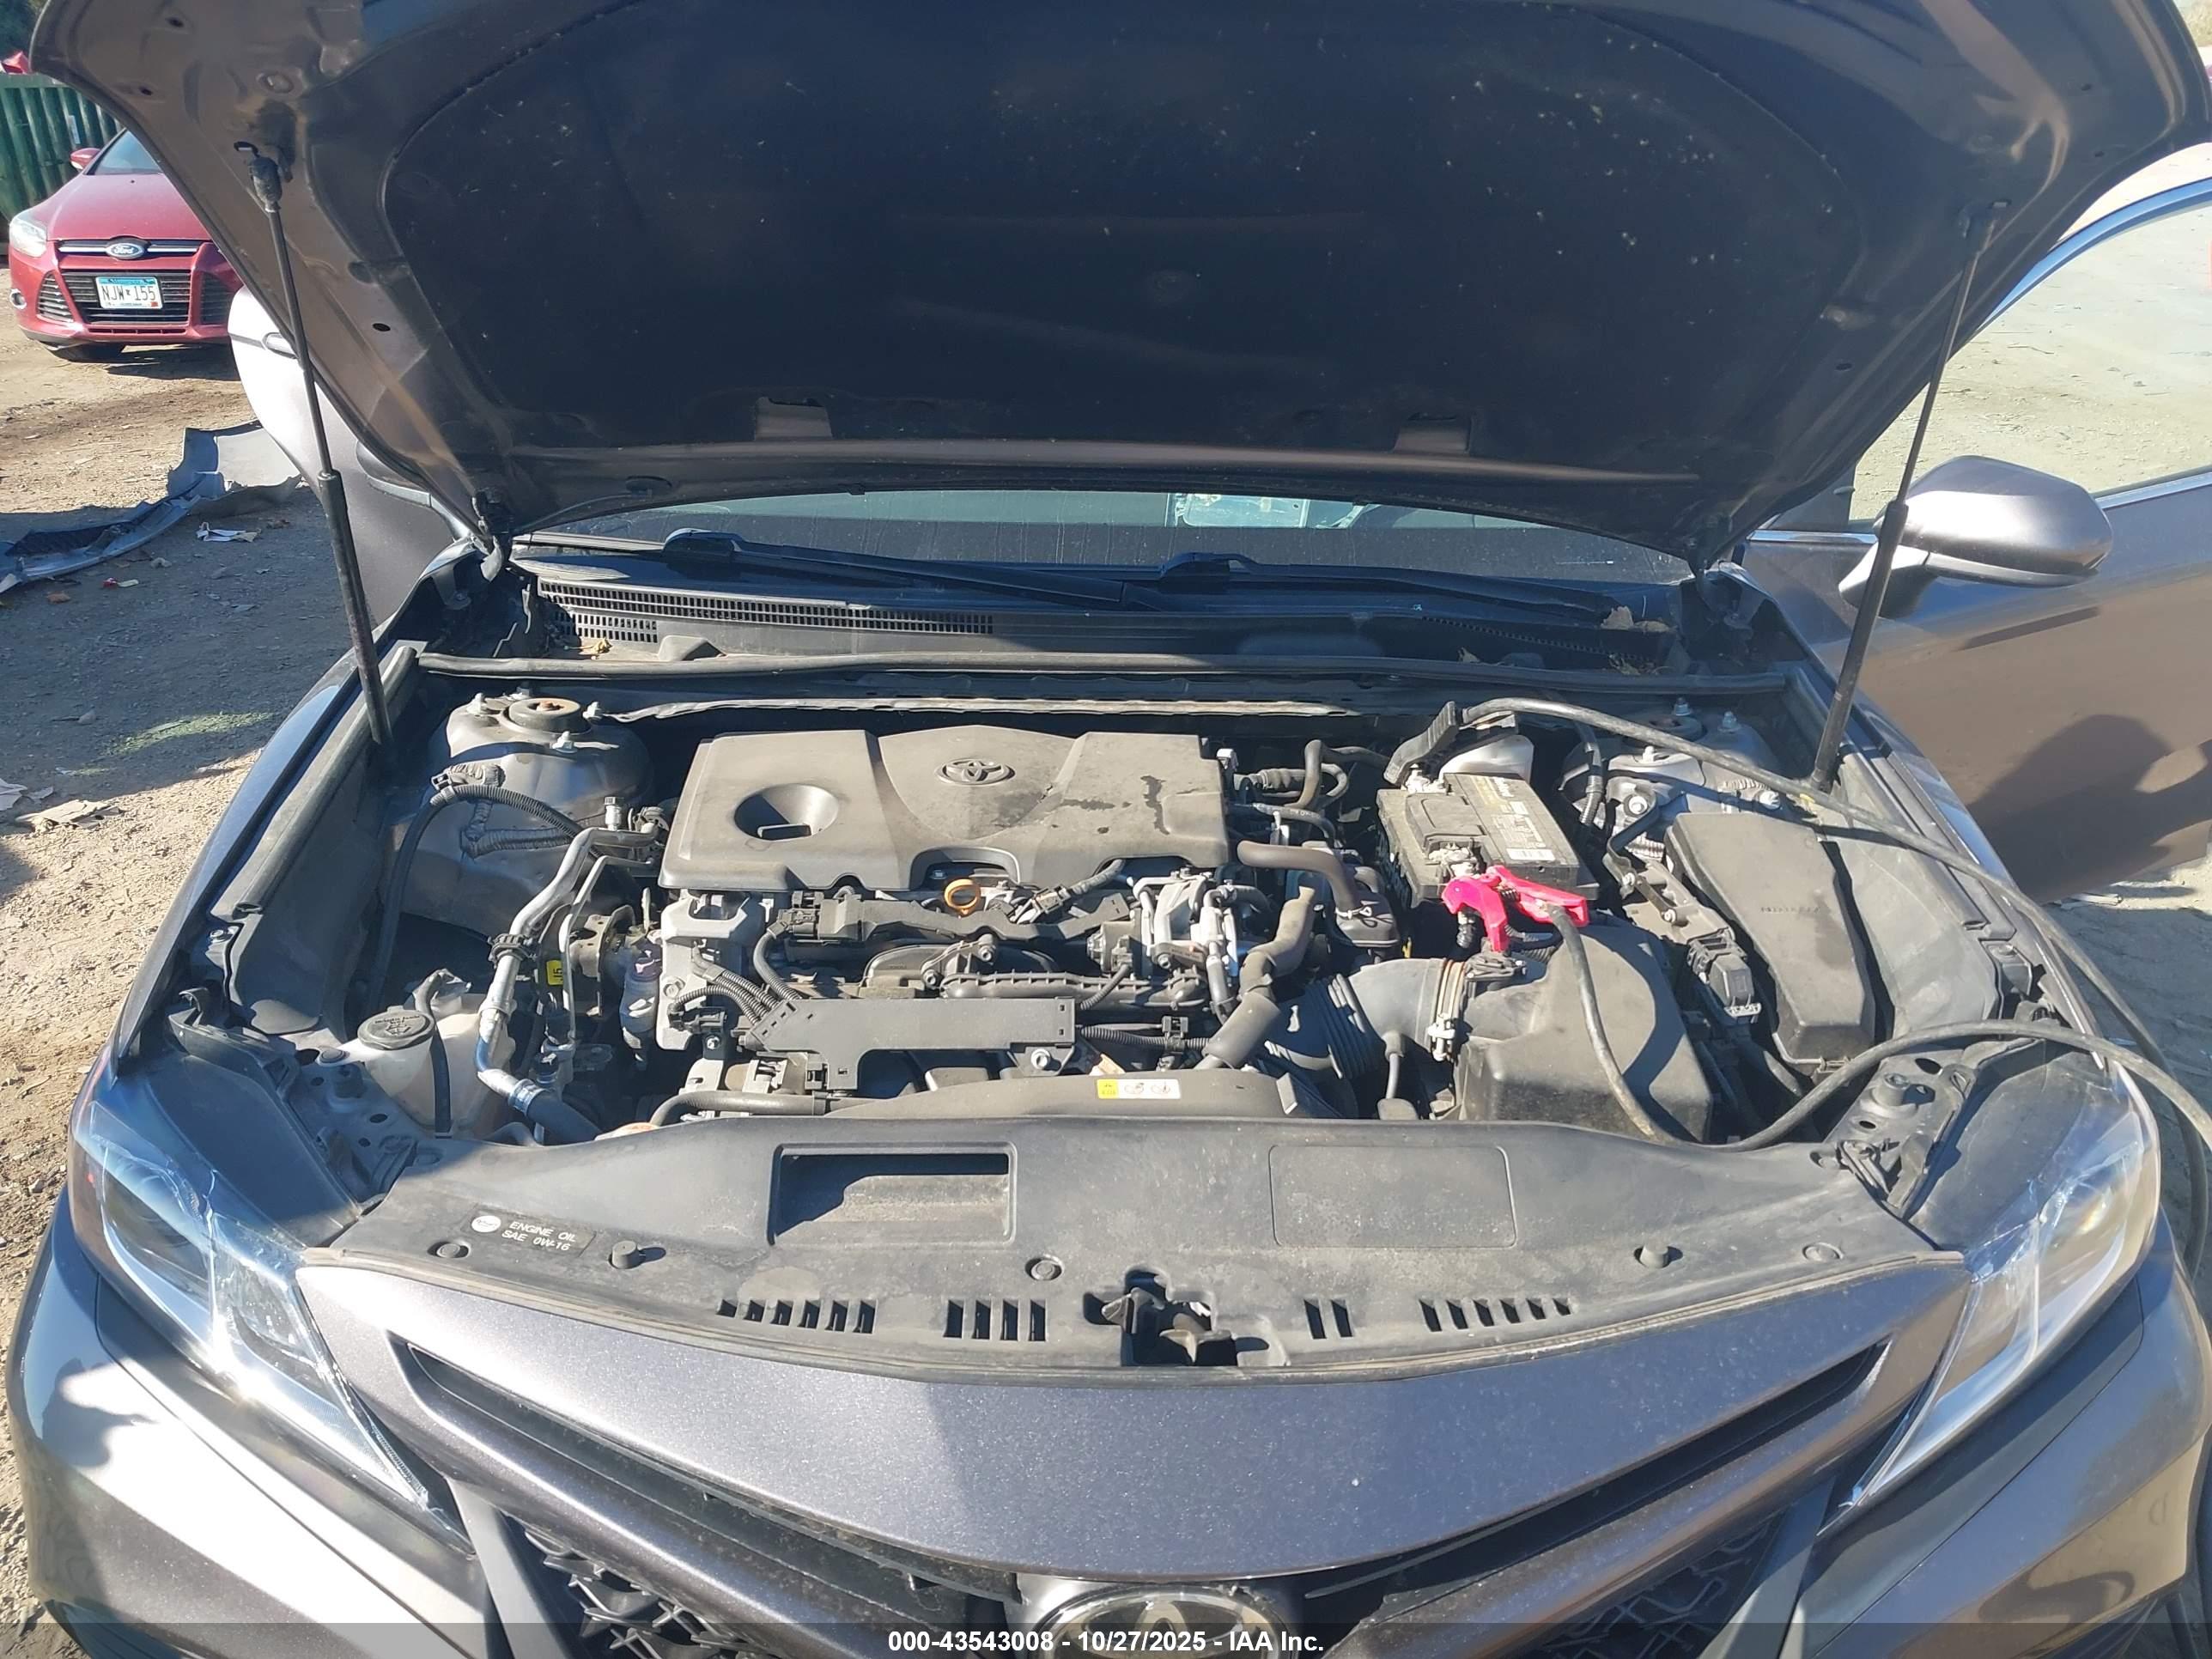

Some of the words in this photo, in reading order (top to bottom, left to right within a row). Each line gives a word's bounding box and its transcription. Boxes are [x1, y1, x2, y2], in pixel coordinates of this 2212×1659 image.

[113, 245, 136, 254] Ford
[101, 285, 125, 301] NJW
[134, 285, 156, 301] 155
[501, 1230, 529, 1242] SAE
[532, 1237, 571, 1251] 0W-16
[509, 1221, 554, 1237] ENGINE
[558, 1231, 577, 1243] OIL
